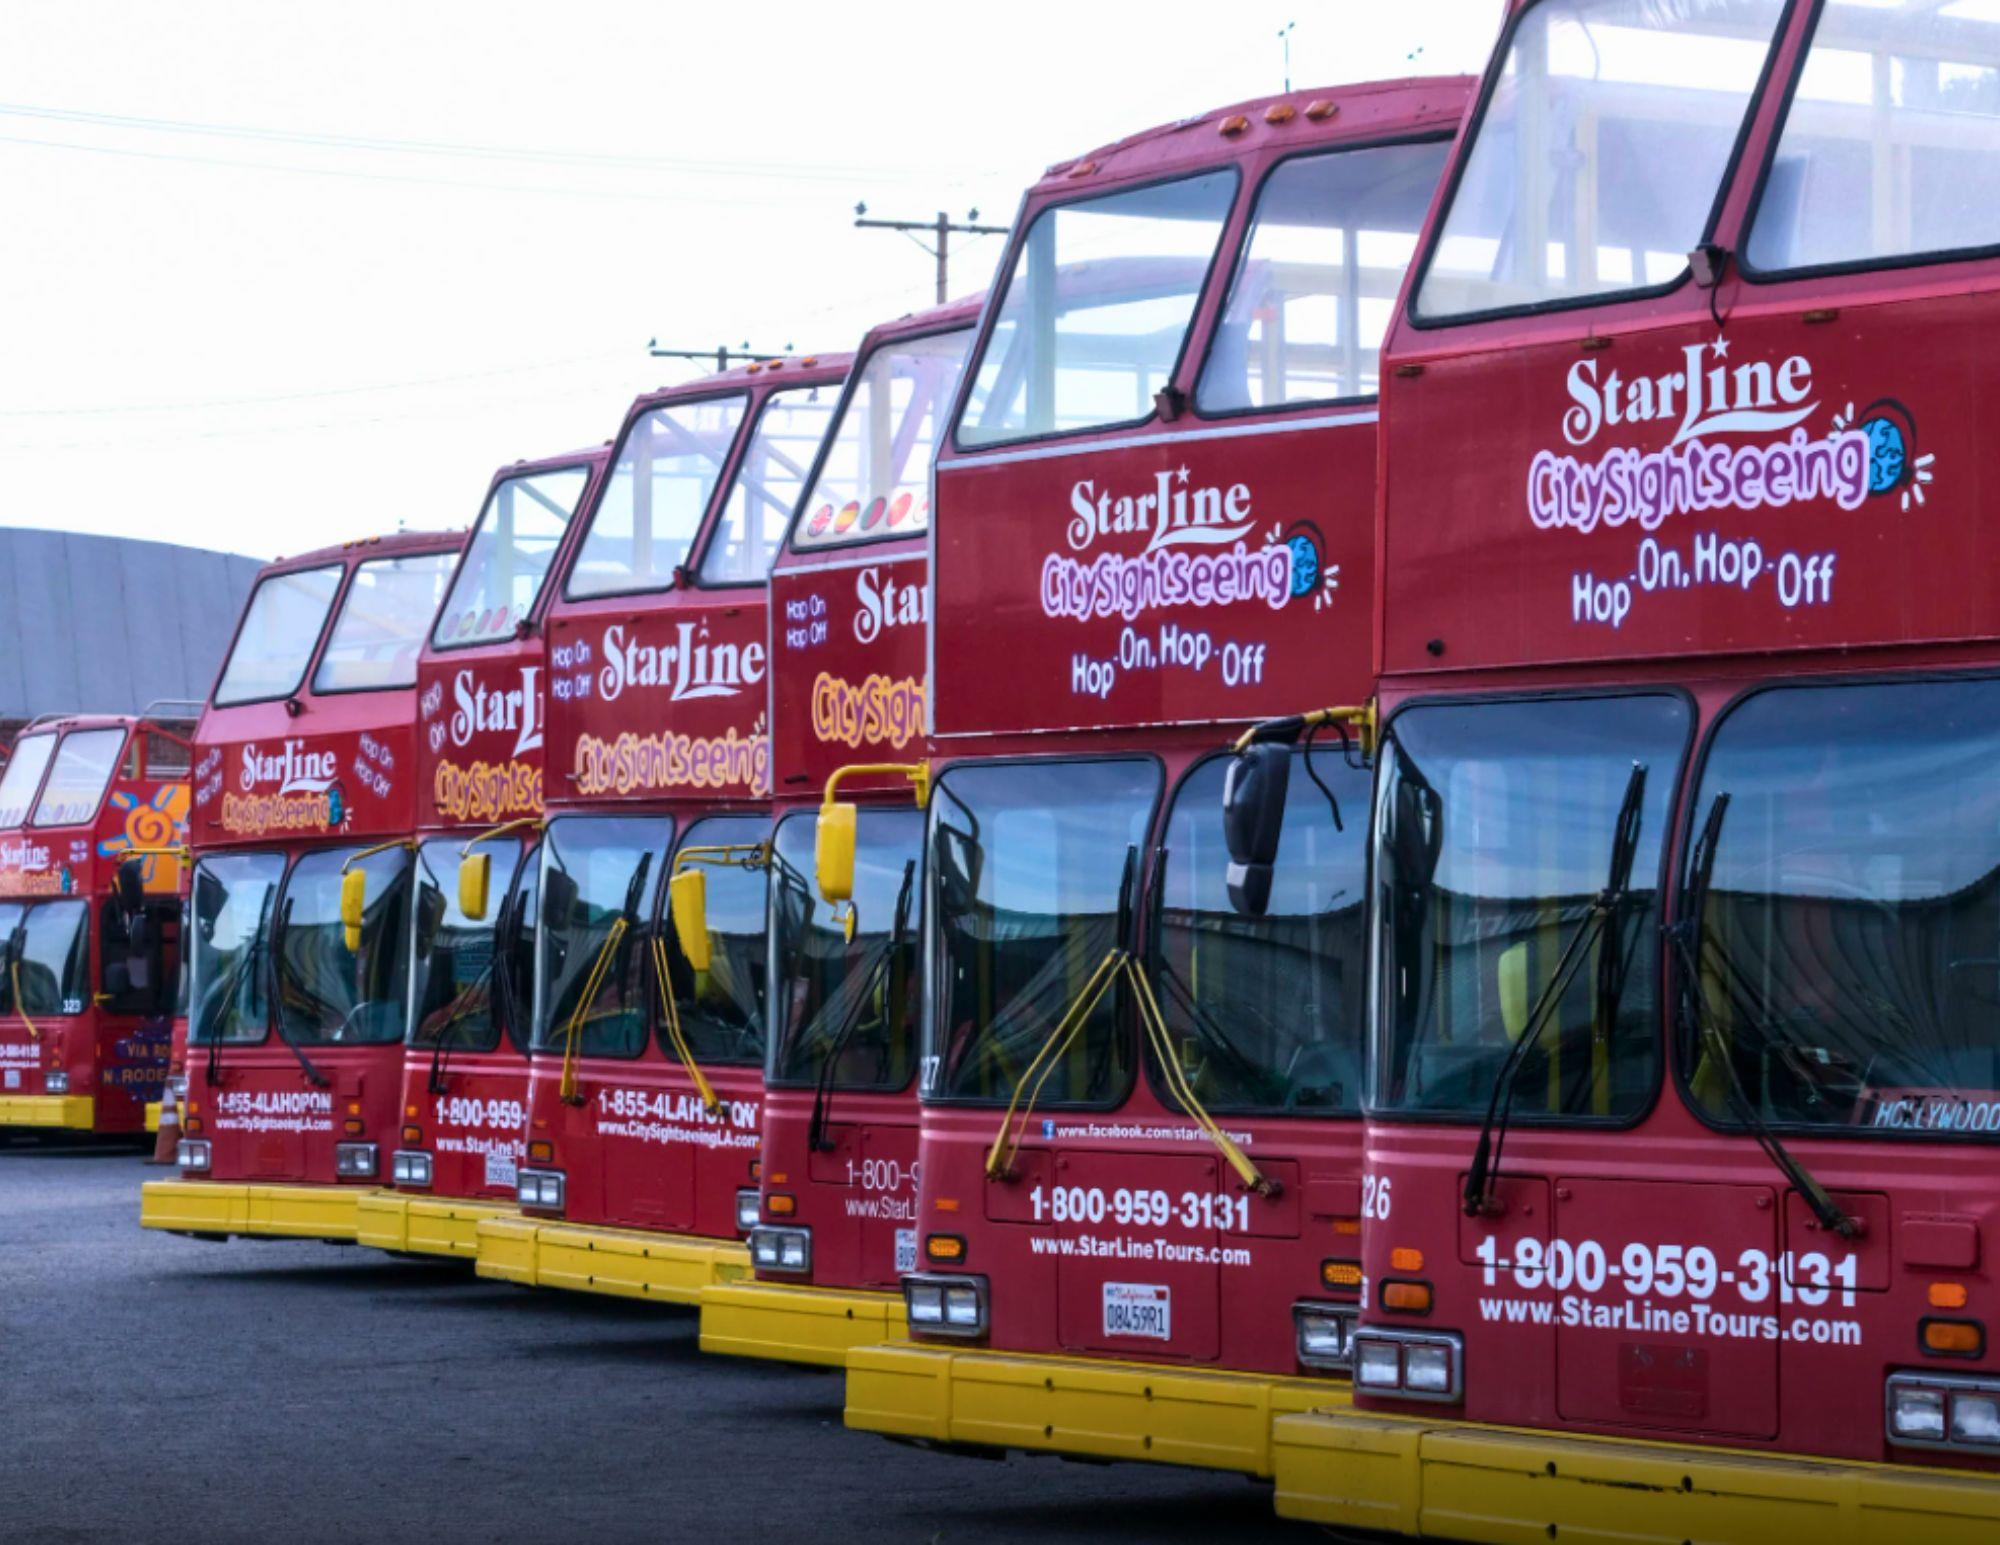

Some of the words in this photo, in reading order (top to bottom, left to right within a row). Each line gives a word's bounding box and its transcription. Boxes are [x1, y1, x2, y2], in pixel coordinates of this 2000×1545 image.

[1561, 334, 1821, 447] StarLine
[1066, 464, 1257, 554] StarLine
[787, 600, 807, 620] Hop
[810, 595, 826, 616] On
[552, 646, 571, 667] Hop
[576, 639, 591, 663] On
[787, 628, 807, 650] Hop
[810, 621, 827, 645] Off
[598, 615, 766, 702] StarLine
[552, 678, 571, 701] Hop
[576, 674, 592, 696] Off
[240, 738, 340, 796] StarLine
[359, 732, 379, 759] Hop
[379, 746, 394, 768] On
[354, 756, 374, 784] Hop
[62, 999, 82, 1014] 323
[127, 1042, 149, 1058] VIA
[1029, 1185, 1250, 1232] 1-800-959-3131
[1361, 1173, 1392, 1220] 26
[1030, 1234, 1251, 1266] www.StarLineTours.com
[1476, 1234, 1858, 1308] 1-800-959-3131
[1478, 1295, 1863, 1346] www.StarLineTours.com
